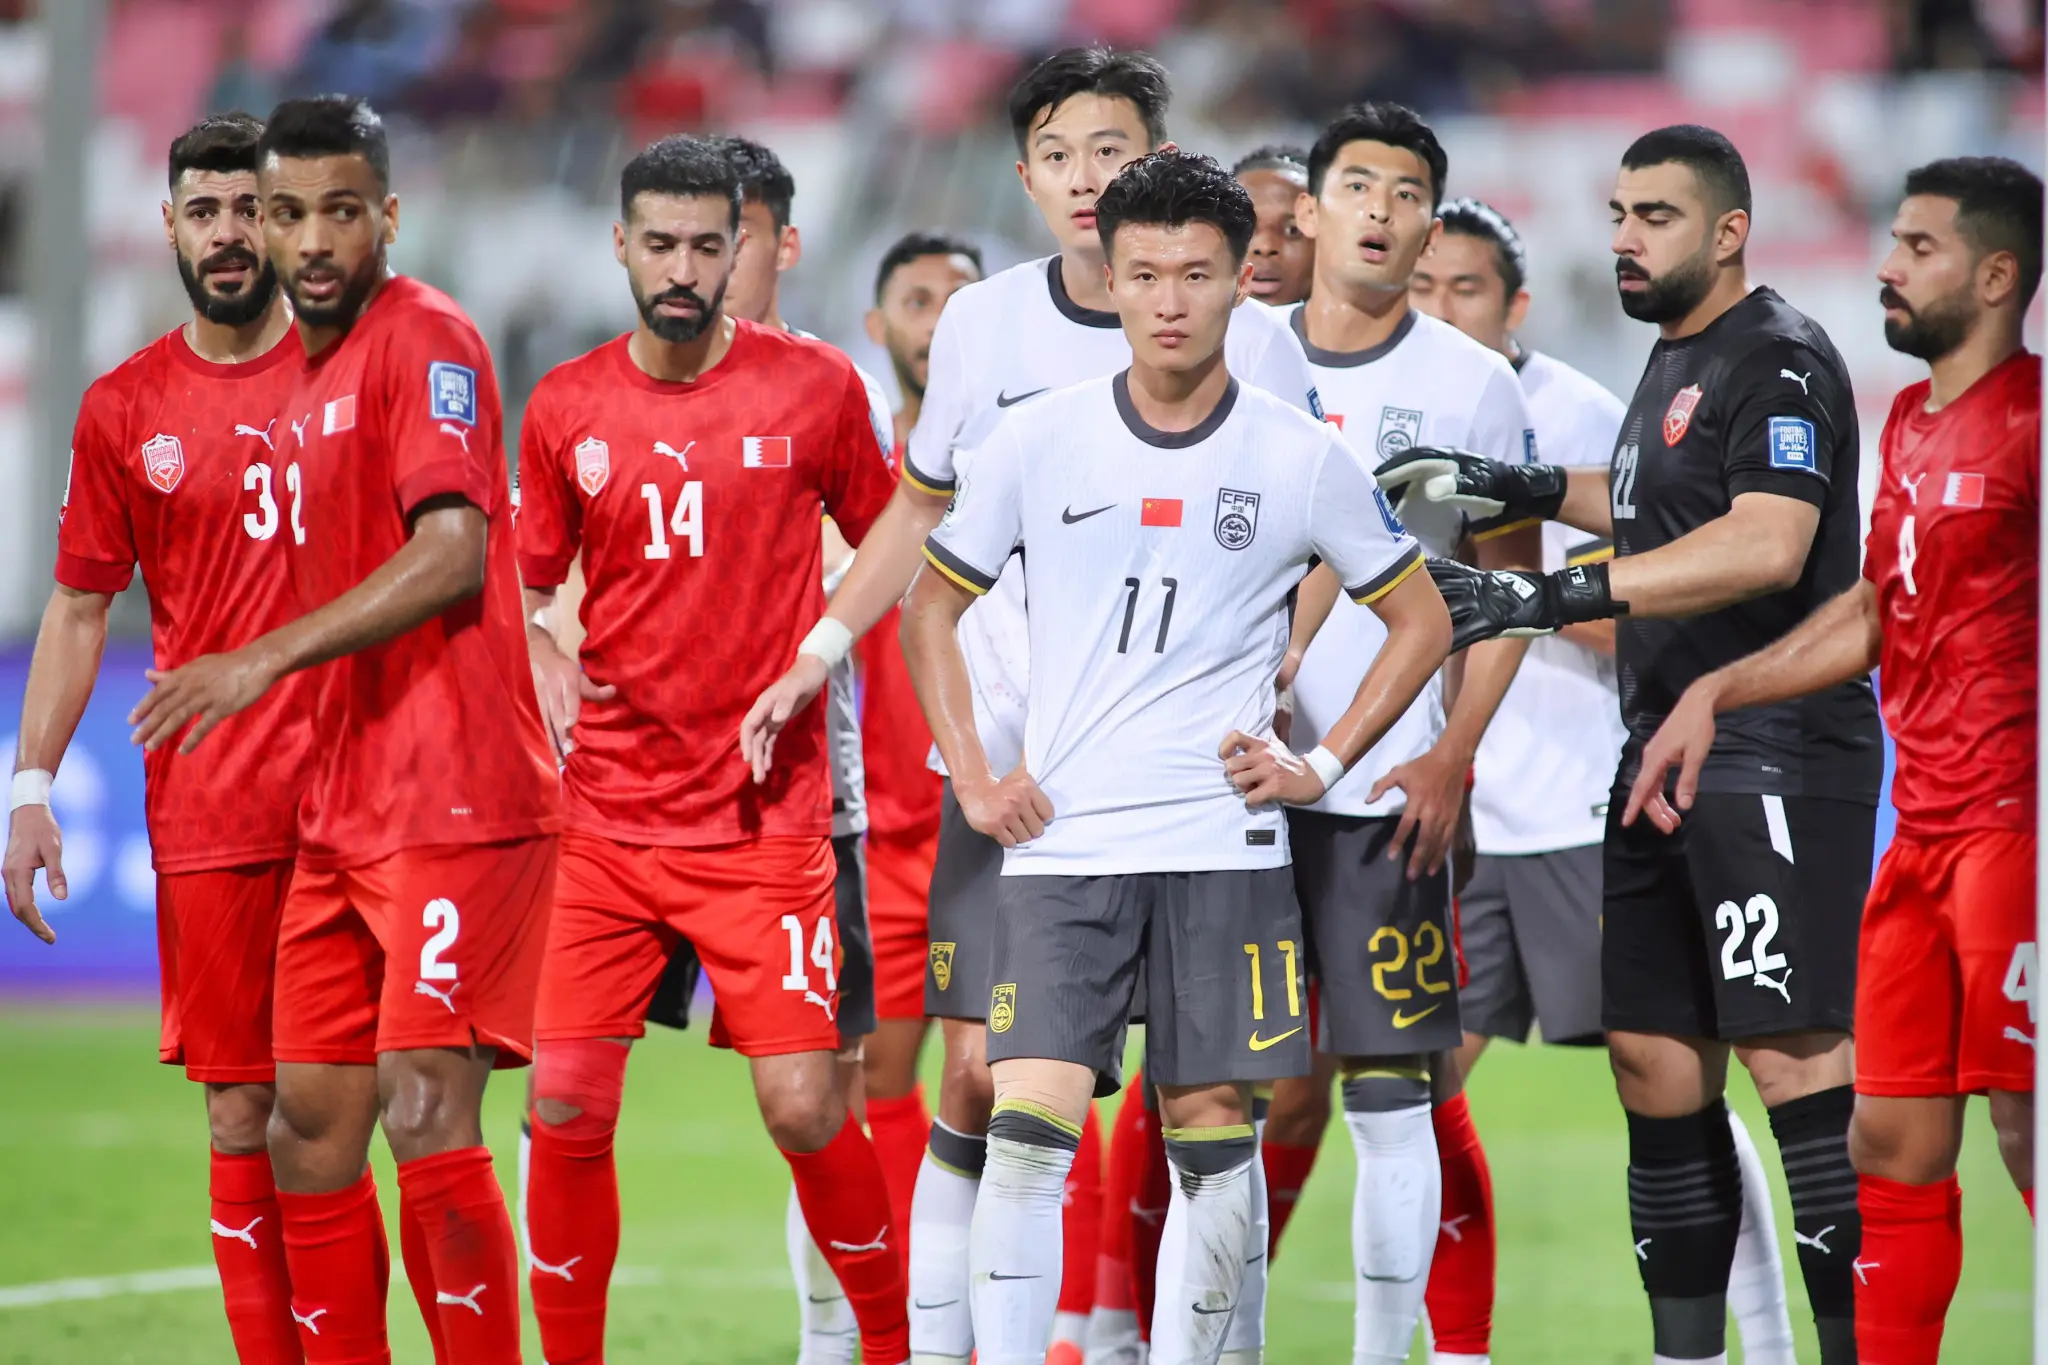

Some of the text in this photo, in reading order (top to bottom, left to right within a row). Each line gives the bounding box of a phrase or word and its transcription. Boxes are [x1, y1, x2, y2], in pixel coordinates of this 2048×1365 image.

[1386, 410, 1418, 424] CFA
[1780, 433, 1807, 443] UNITES
[244, 462, 278, 541] 3
[286, 461, 305, 546] 2
[641, 480, 703, 560] 14
[1222, 492, 1256, 508] CFA
[1613, 444, 1639, 519] 22
[1898, 515, 1917, 595] 4
[1117, 577, 1177, 654] 11
[420, 897, 460, 980] 2
[781, 914, 837, 991] 14
[1368, 920, 1450, 1000] 22
[1715, 893, 1787, 980] 22
[993, 986, 1014, 998] CFA
[1243, 940, 1300, 1020] 11
[2002, 941, 2040, 1024] 4
